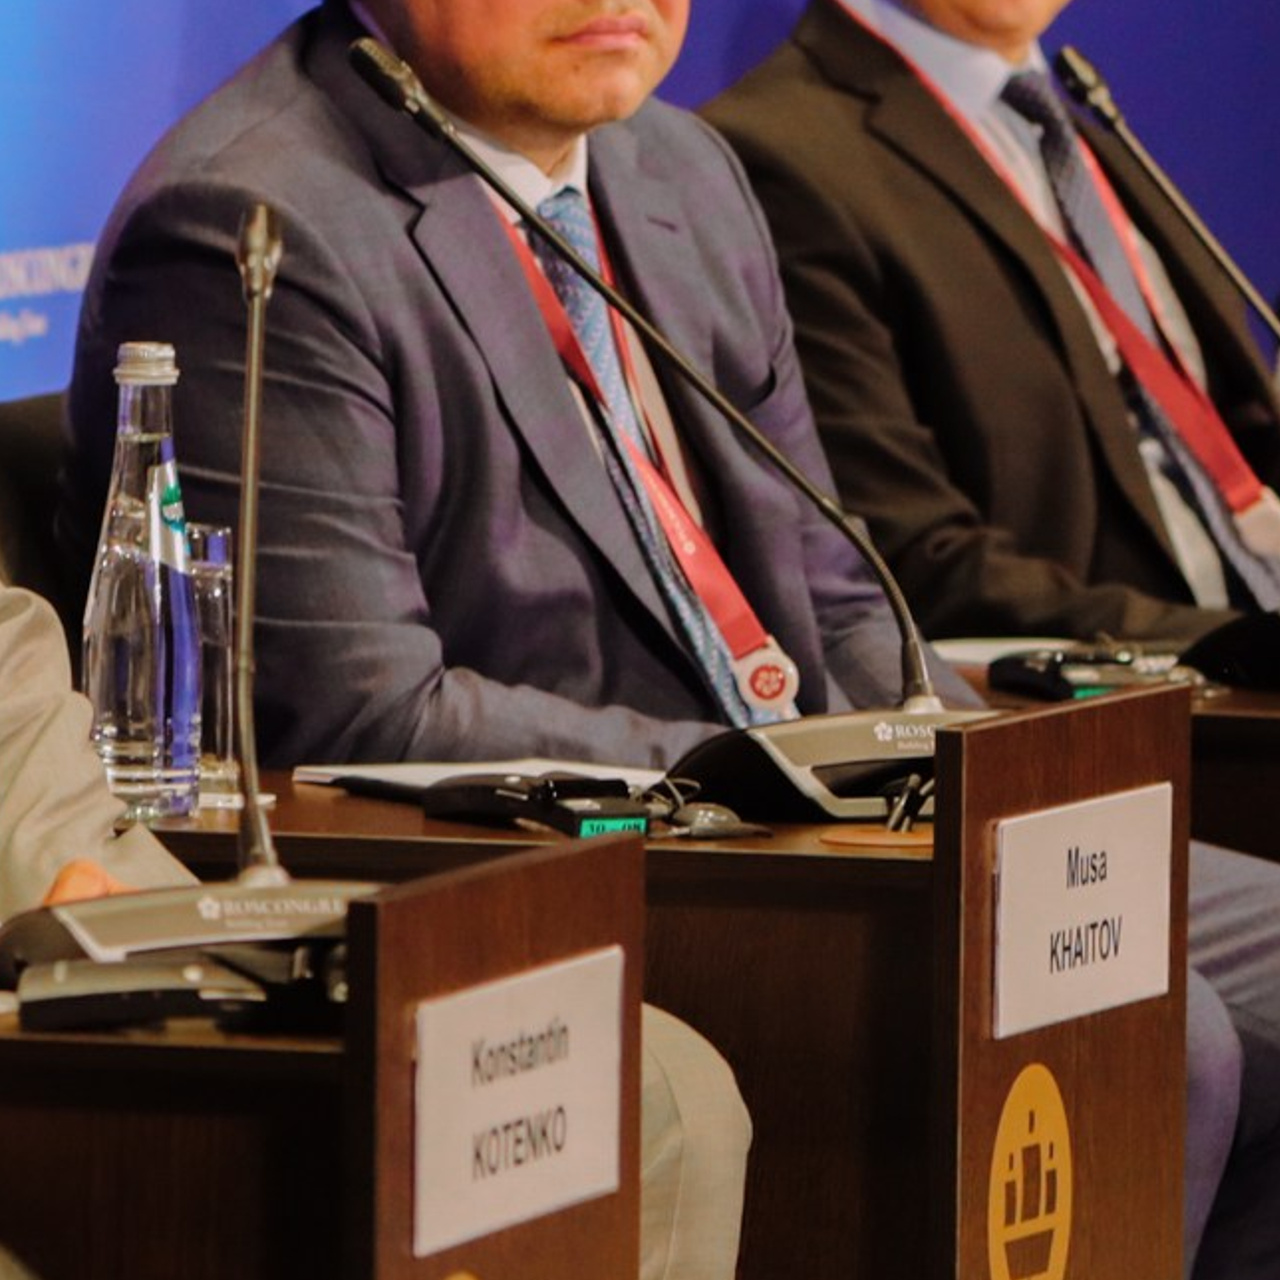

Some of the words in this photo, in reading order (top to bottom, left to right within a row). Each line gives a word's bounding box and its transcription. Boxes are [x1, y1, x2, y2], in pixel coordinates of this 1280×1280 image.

[1066, 846, 1108, 890] Musa
[1049, 915, 1123, 974] KHAITOV
[471, 1017, 569, 1087] Konstantin
[472, 1105, 568, 1181] KOTENKO
